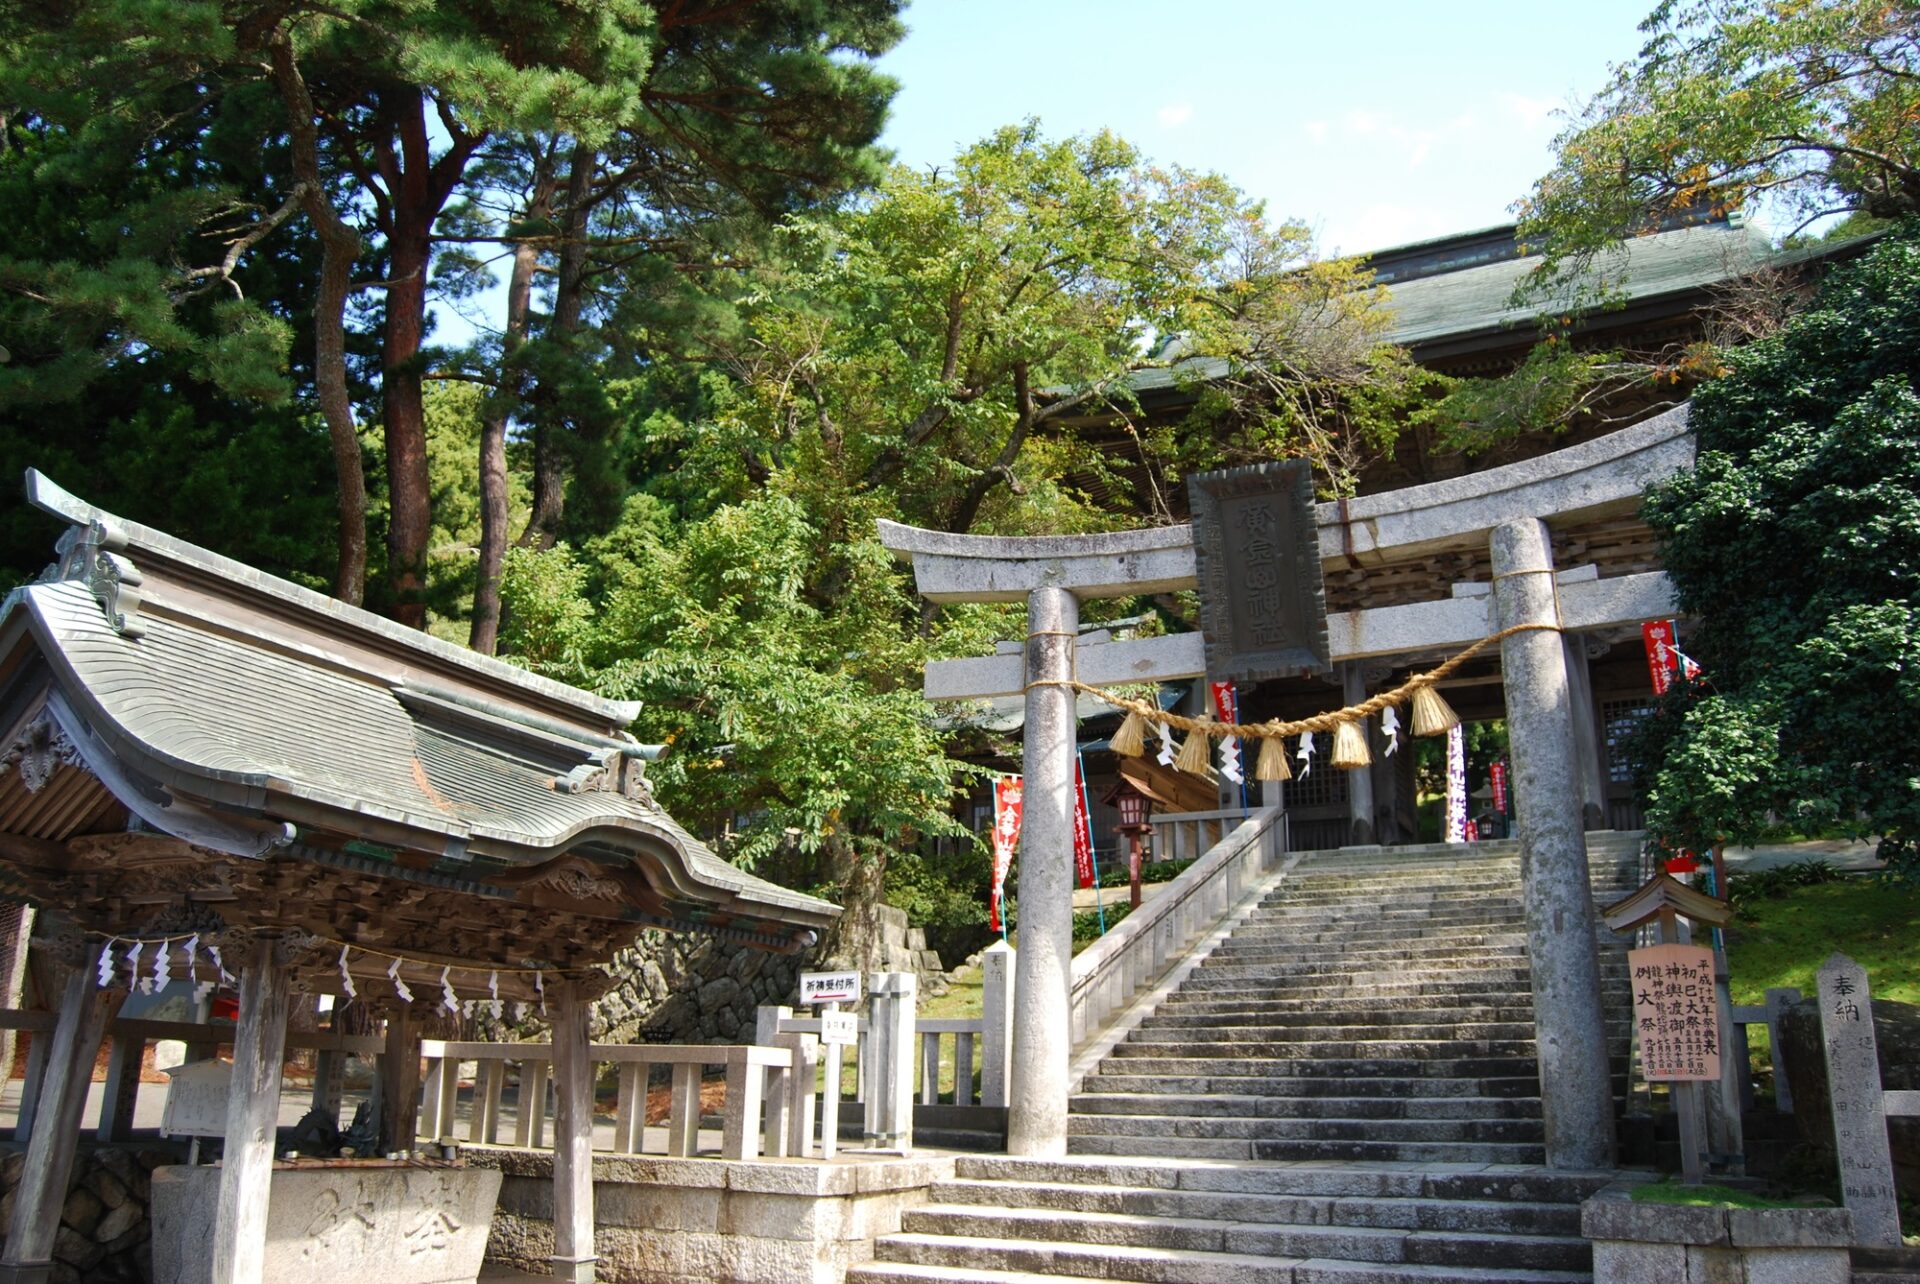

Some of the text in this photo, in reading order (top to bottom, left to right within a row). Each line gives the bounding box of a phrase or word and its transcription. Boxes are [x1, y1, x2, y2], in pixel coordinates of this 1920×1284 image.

[806, 978, 855, 992] 祈祷受付所
[1635, 966, 1657, 1031] 例大祭
[1832, 976, 1860, 1022] 奉納
